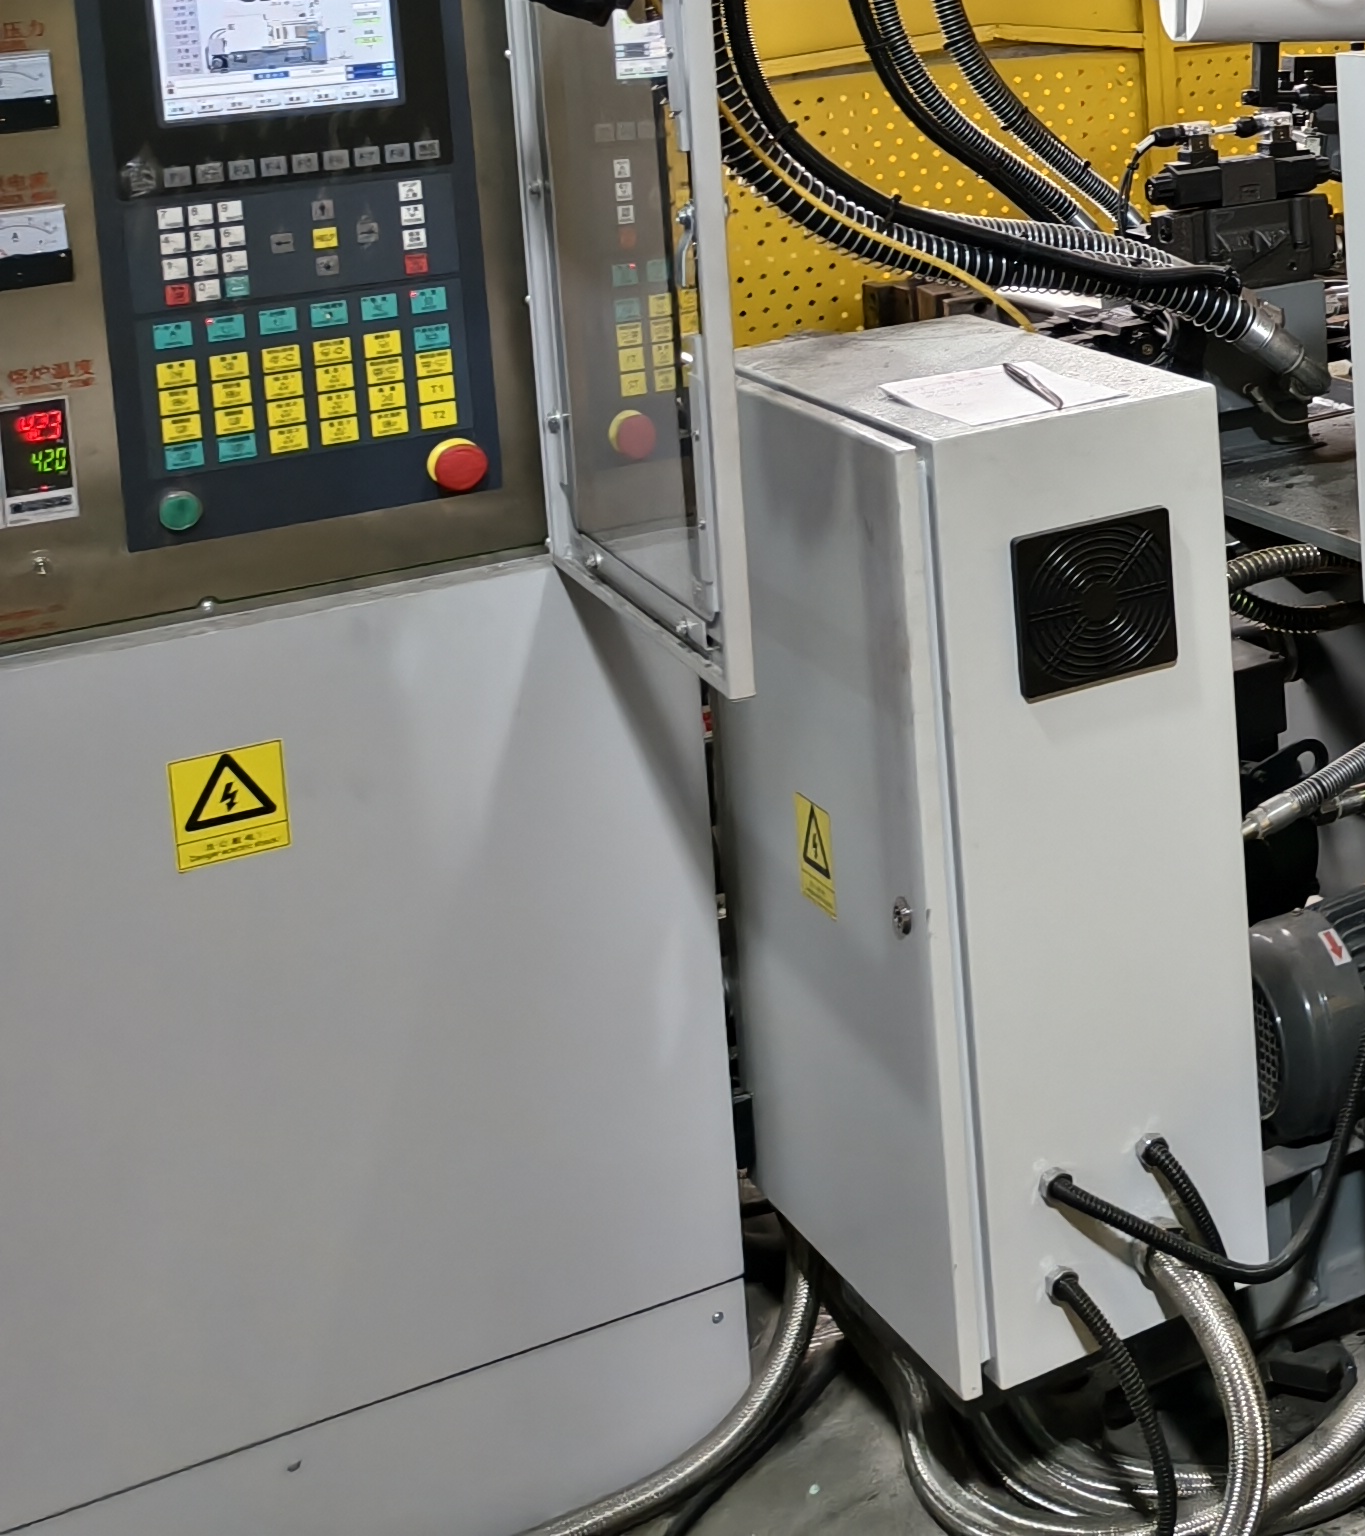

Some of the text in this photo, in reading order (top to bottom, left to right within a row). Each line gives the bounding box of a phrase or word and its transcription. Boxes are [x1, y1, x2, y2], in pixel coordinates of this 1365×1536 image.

[430, 384, 445, 393] T1
[432, 410, 446, 419] T2
[31, 447, 67, 472] 420
